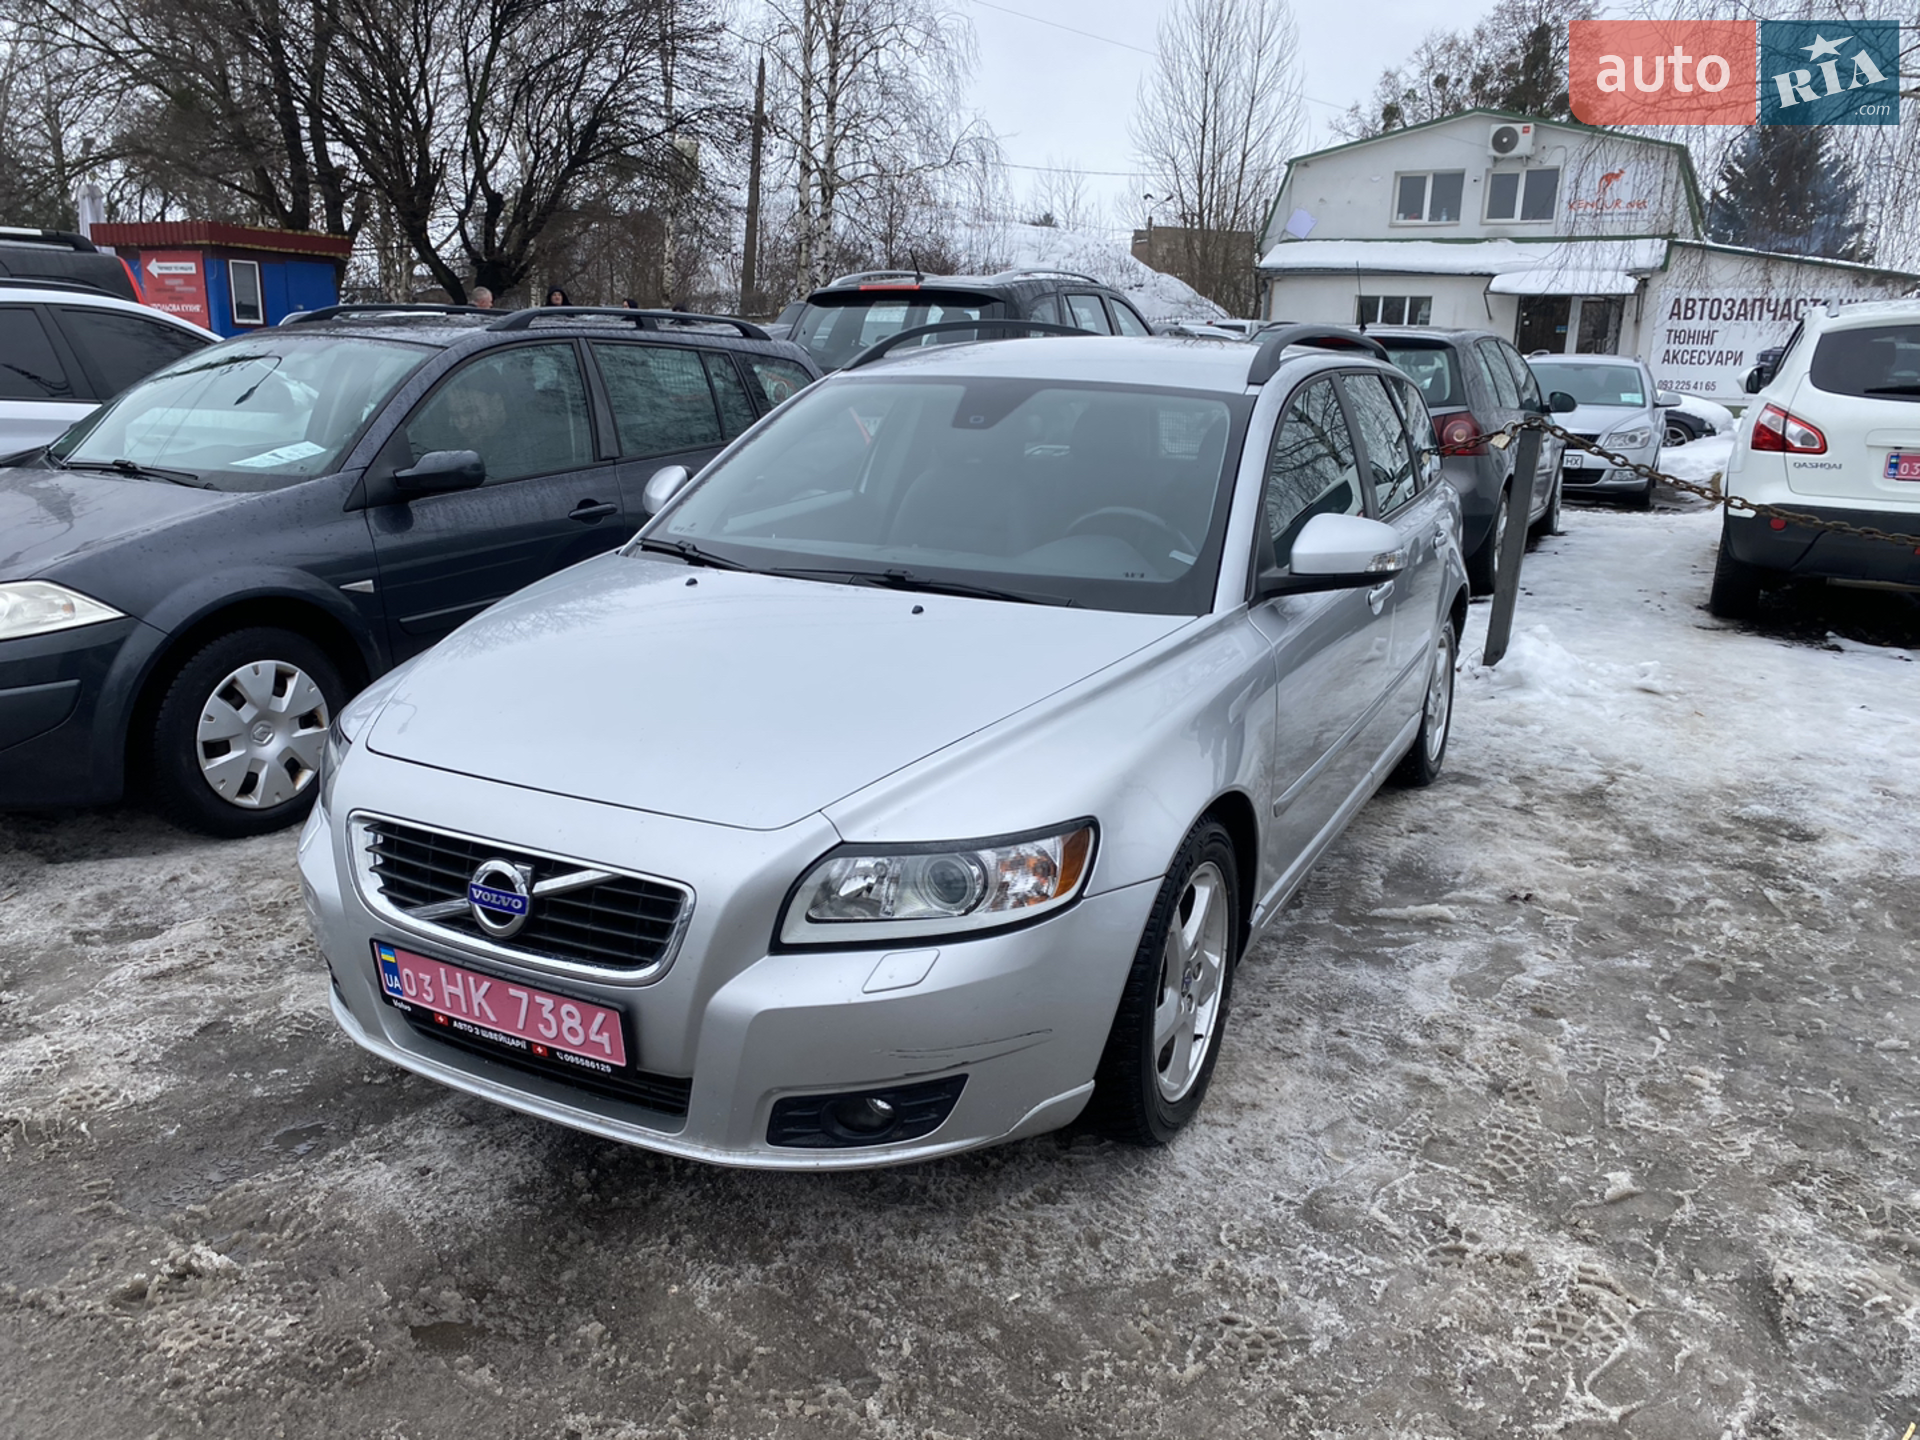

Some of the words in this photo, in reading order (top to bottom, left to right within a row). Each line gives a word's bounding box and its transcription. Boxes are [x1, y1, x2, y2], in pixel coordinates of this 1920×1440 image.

[1668, 297, 1869, 321] АВТОЗАПЧАС
[1666, 329, 1719, 346] ТЮНІНГ
[1661, 349, 1744, 367] АКСЕСУАРИ
[1657, 379, 1674, 391] 093
[1675, 380, 1691, 390] 225
[1692, 381, 1703, 391] 41
[1705, 381, 1717, 391] 65
[1793, 462, 1842, 470] QASHQAI
[1900, 462, 1920, 476] 03
[471, 887, 523, 909] VOLVO
[385, 973, 402, 991] UA
[402, 968, 434, 1003] 03
[439, 967, 498, 1023] HK
[508, 988, 612, 1055] 7384
[453, 1020, 473, 1033] АВТО
